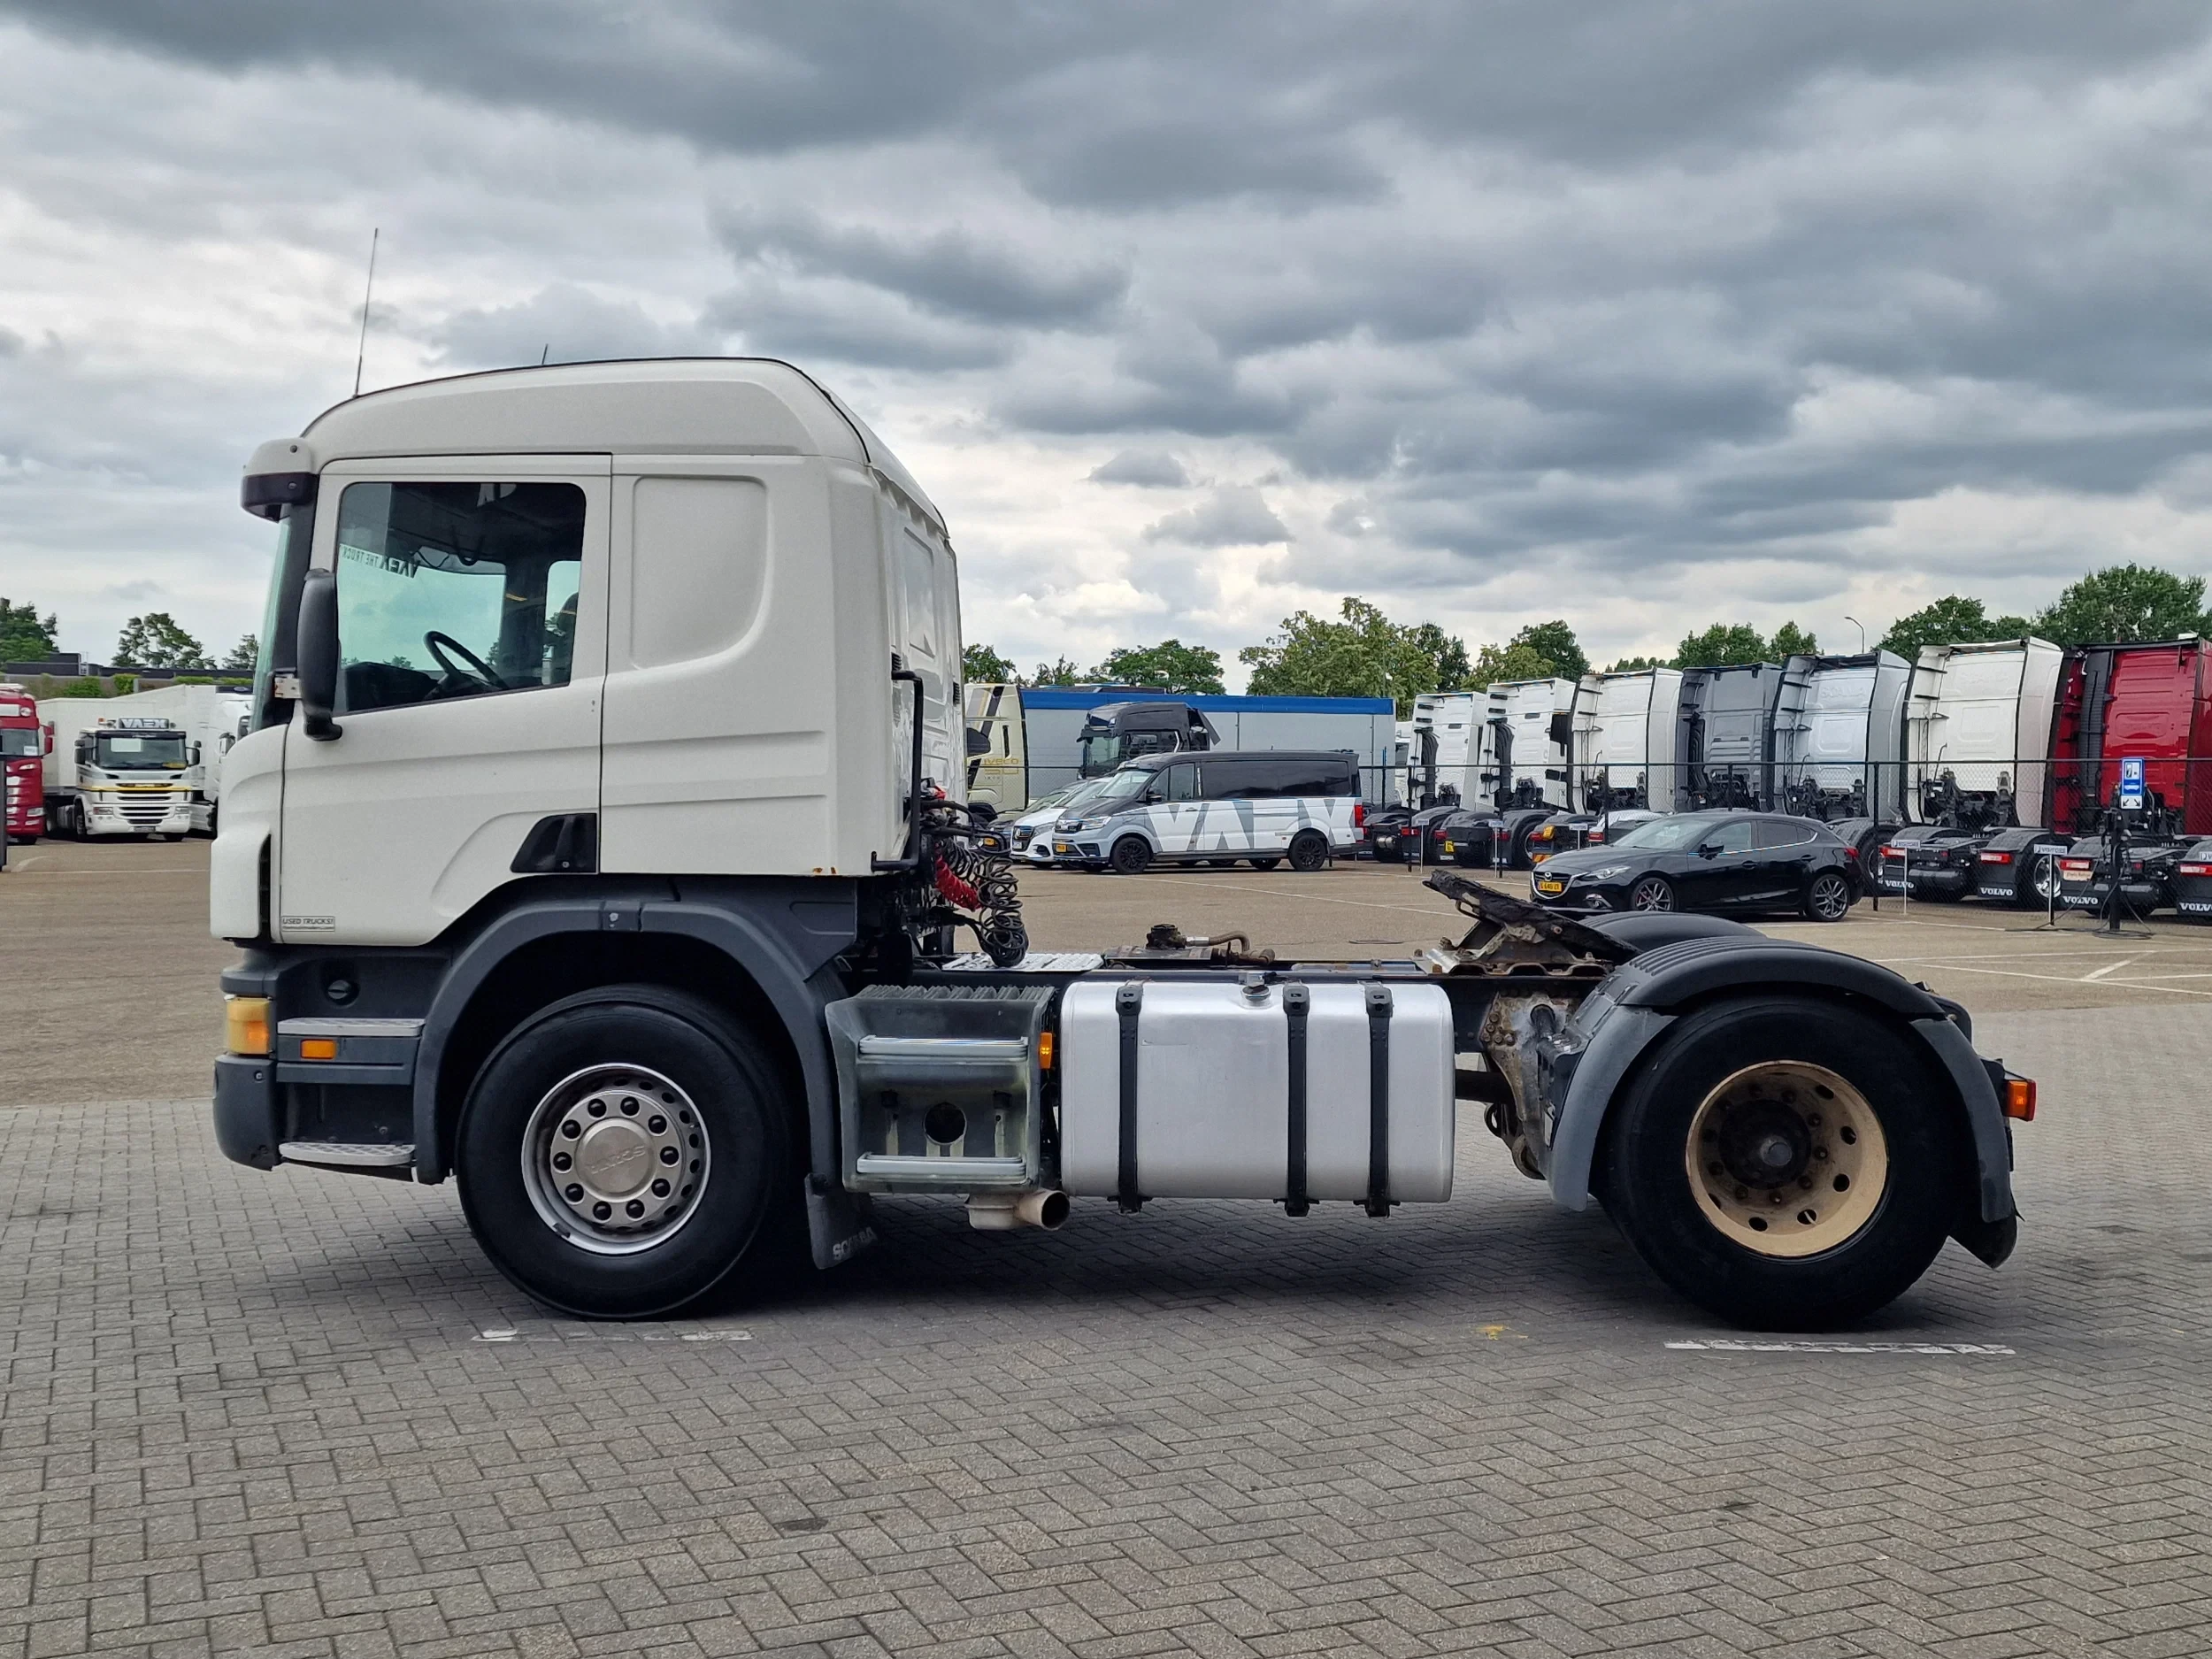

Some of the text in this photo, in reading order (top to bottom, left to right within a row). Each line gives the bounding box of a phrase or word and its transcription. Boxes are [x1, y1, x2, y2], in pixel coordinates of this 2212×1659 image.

[1885, 879, 1915, 889] VOLVO
[1980, 887, 2013, 896] VOLVO
[2062, 895, 2099, 905] VOLVO
[2179, 902, 2212, 911] VOLV
